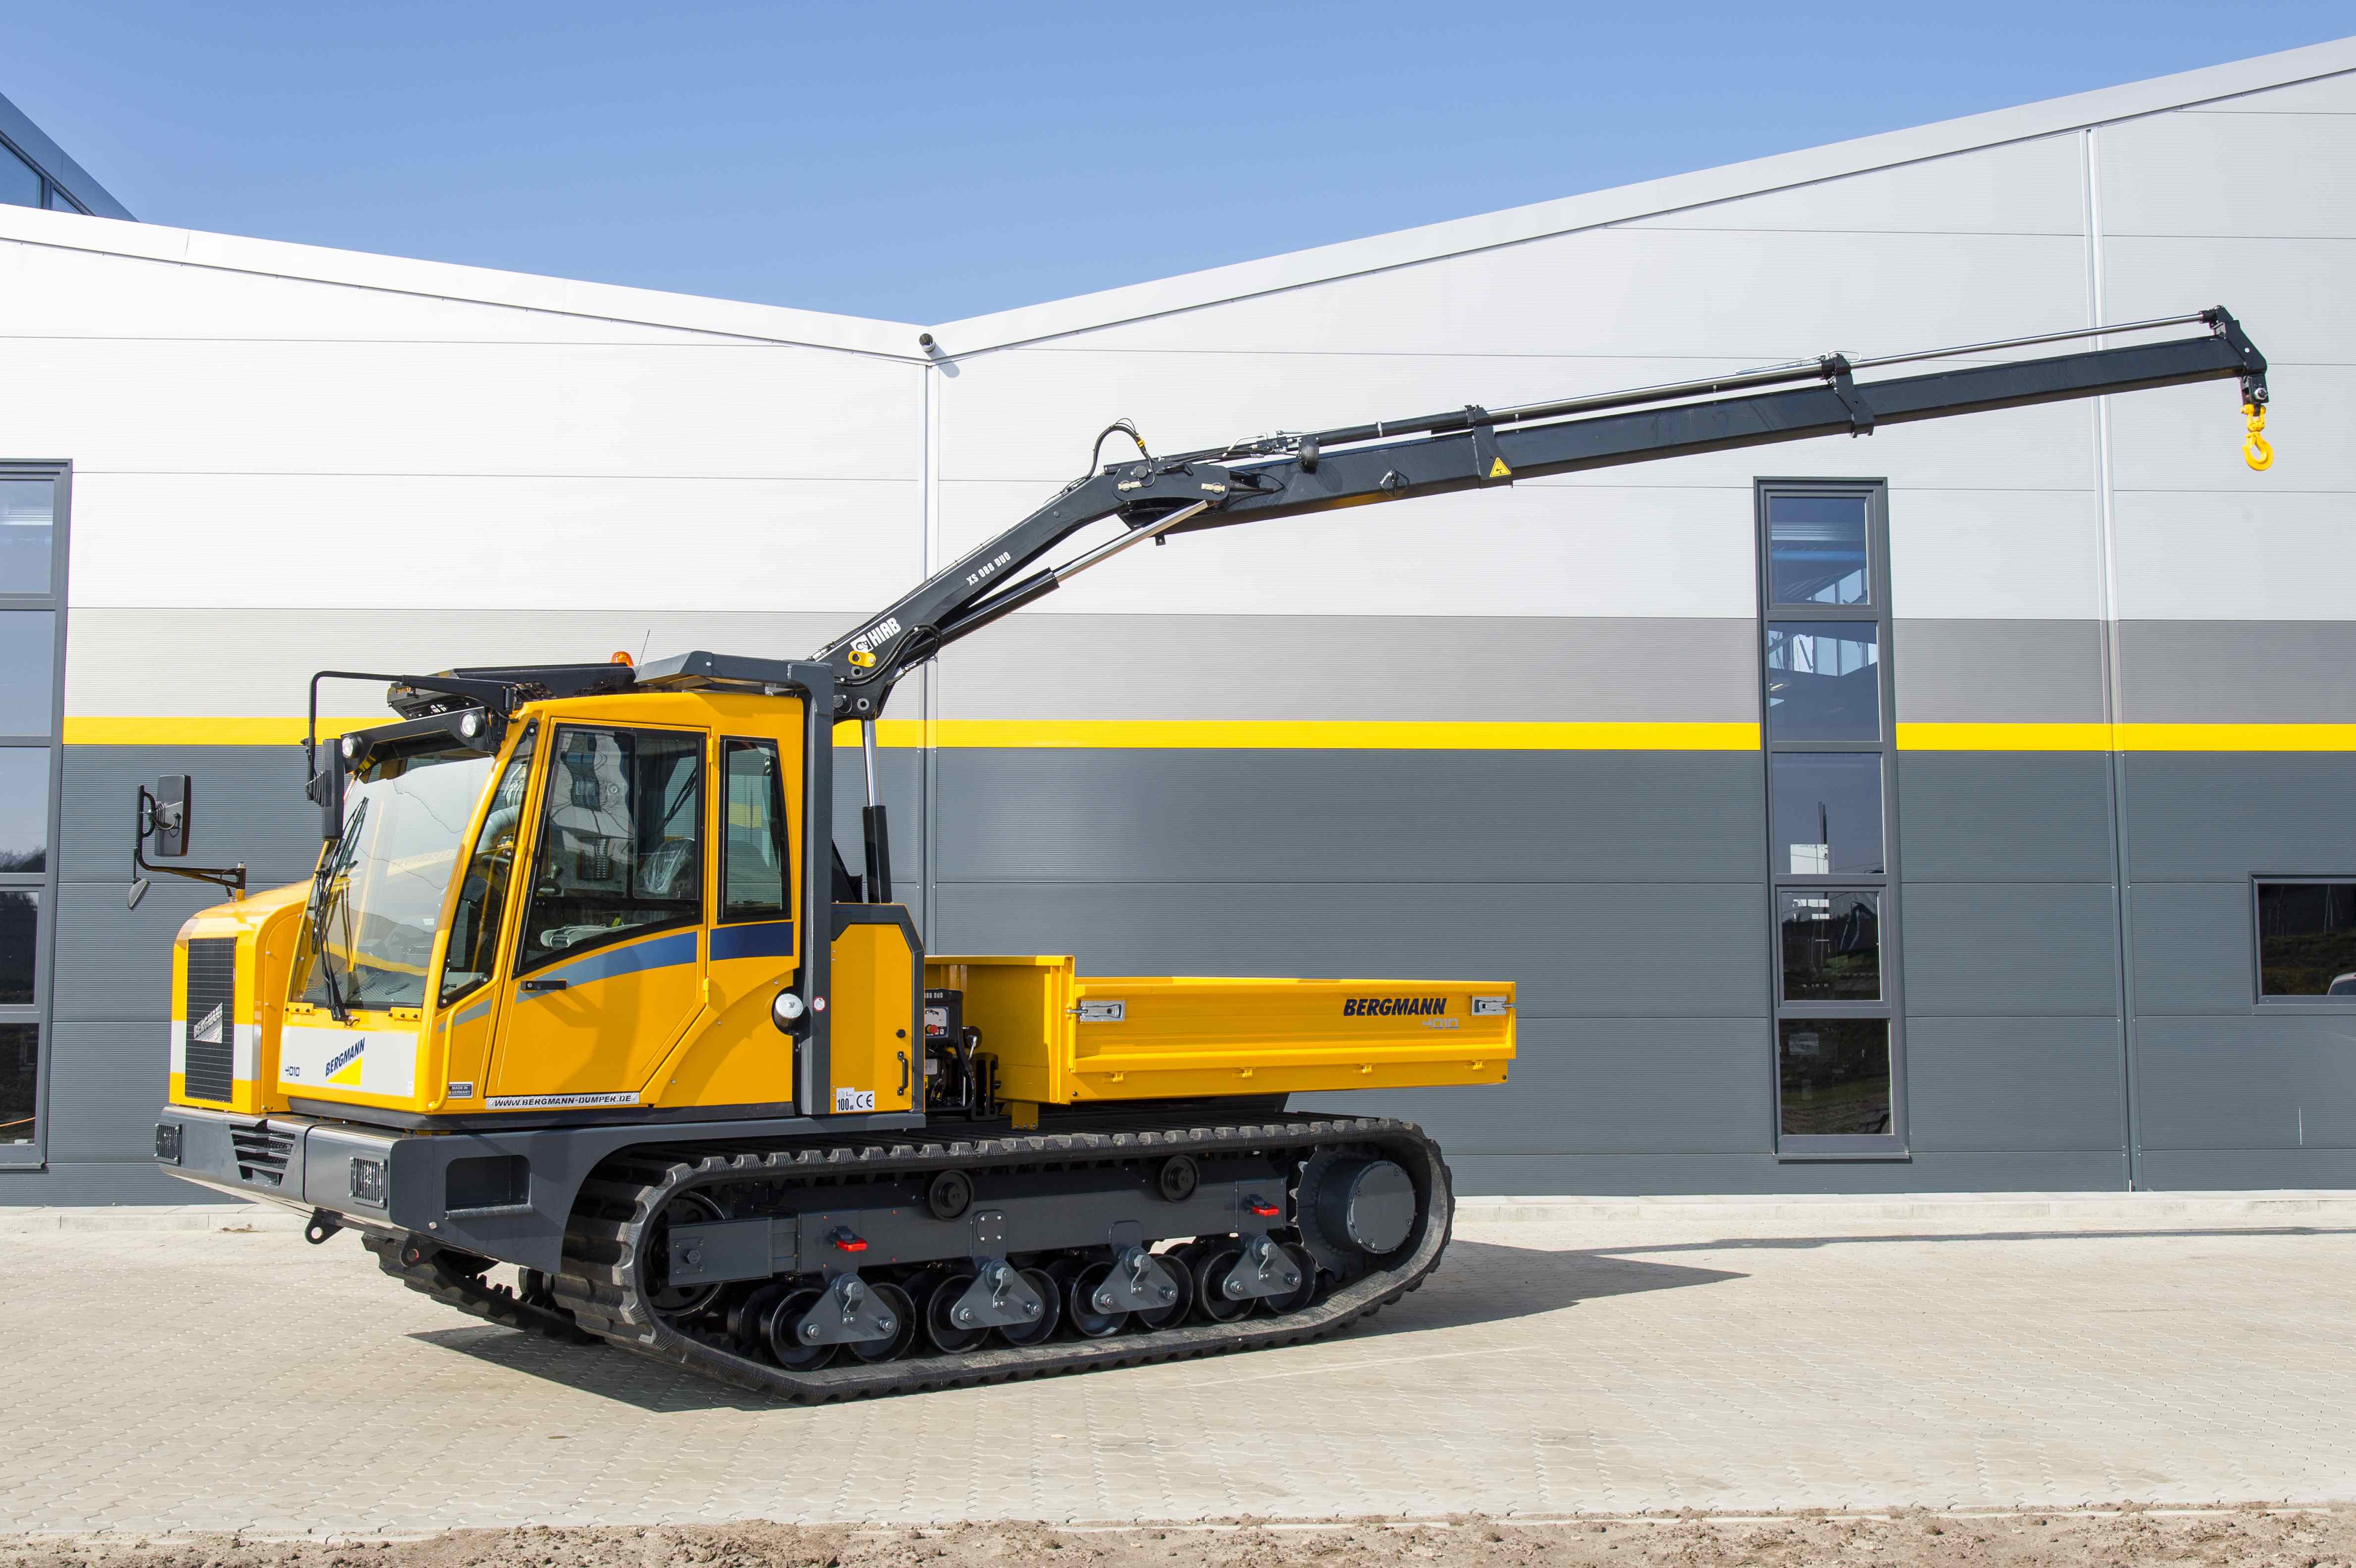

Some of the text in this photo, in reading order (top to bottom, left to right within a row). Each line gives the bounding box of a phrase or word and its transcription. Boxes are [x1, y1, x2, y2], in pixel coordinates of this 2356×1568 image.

[966, 552, 1011, 586] XS 088 DUO
[867, 617, 901, 647] HIAB
[1343, 998, 1447, 1016] BERGMANN
[1422, 1017, 1458, 1029] 4010
[325, 1037, 365, 1077] BERGMANN
[285, 1066, 300, 1077] 4010
[495, 1095, 631, 1107] WWW.BERGMANN-DUMPER.DE
[837, 1098, 849, 1111] 100
[856, 1094, 872, 1109] CE
